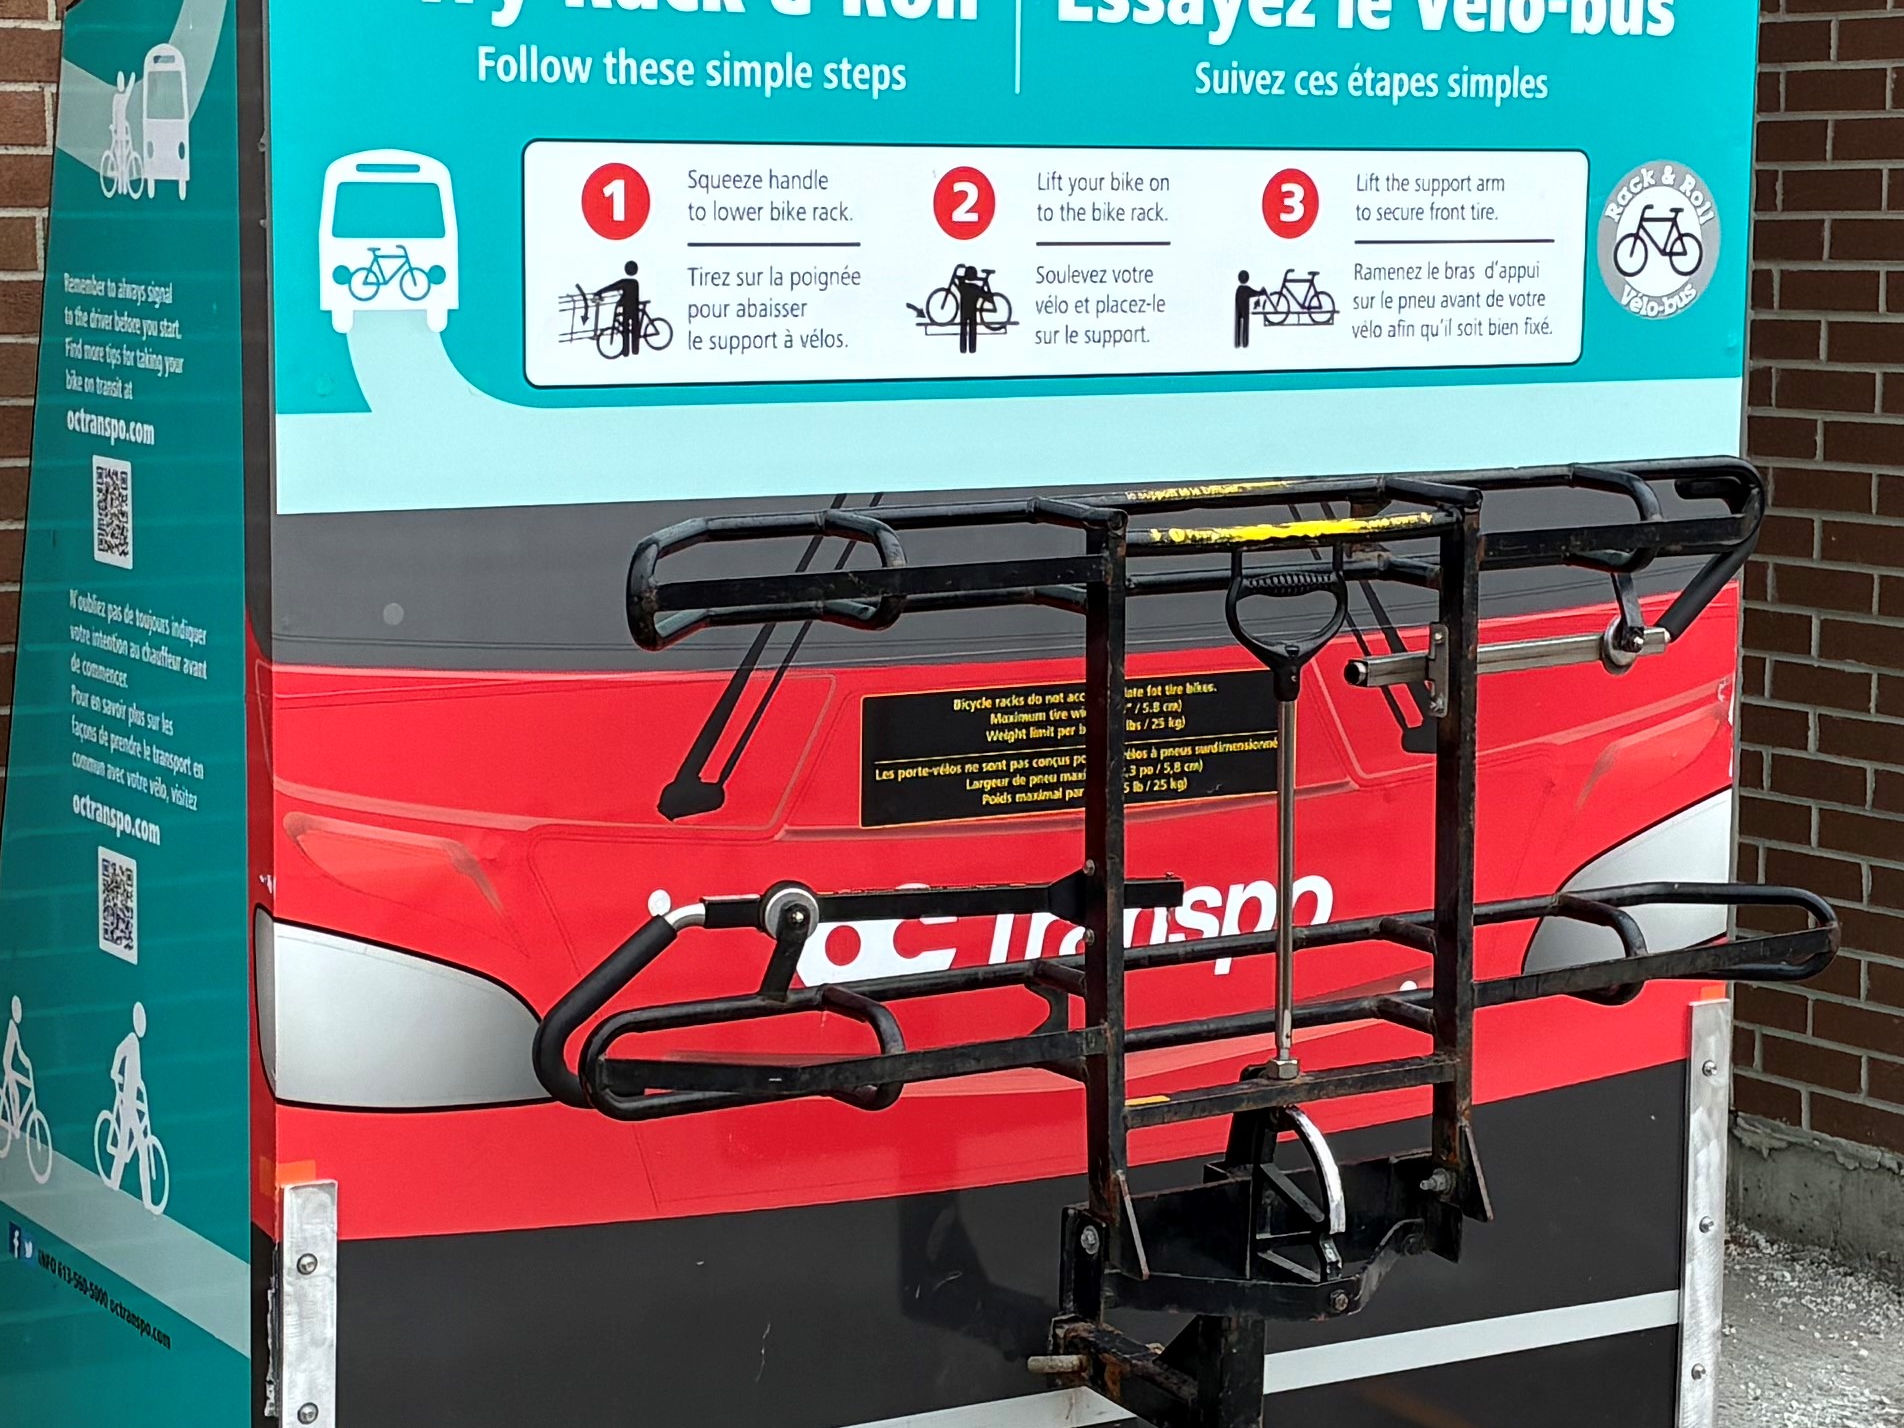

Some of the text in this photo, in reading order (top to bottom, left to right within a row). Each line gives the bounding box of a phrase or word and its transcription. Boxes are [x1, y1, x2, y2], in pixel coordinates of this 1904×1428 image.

[479, 45, 906, 99] Follow these simple steps
[1196, 61, 1547, 106] Suivez ces étapes simples
[688, 169, 828, 194] Squeeze handle
[1038, 171, 1169, 196] Lift your bike on
[1357, 173, 1504, 196] Lift the support arm
[603, 180, 624, 221] 1
[952, 182, 978, 221] 2
[1280, 183, 1304, 221] 3
[1604, 165, 1716, 225] Rack & Roll
[688, 200, 852, 221] to lower bike rack.
[1037, 202, 1168, 221] to the bike rack.
[1356, 202, 1498, 221] to secure front tire.
[687, 265, 861, 291] Tirez sur la poignée
[1036, 265, 1153, 284] Soulevez votre
[1355, 260, 1539, 283] Ramenez le bras d'appui
[64, 273, 172, 308] Remember to always signal
[1353, 290, 1545, 314] sur le pneu avant de votre
[1621, 283, 1696, 317] Vélo-bus
[688, 298, 807, 324] pour abaisser
[1036, 294, 1165, 318] vélo et placez-le
[65, 307, 72, 325] to
[75, 306, 87, 327] the
[90, 308, 112, 330] driver
[114, 310, 141, 335] before
[142, 318, 158, 341] you
[1035, 325, 1149, 348] sur le support.
[1352, 317, 1552, 341] vélo afin qu'il soit bien fixé.
[689, 328, 848, 355] le support à vélos.
[65, 338, 184, 378] Find more tips for taking your
[66, 369, 133, 399] bike on transit at
[67, 408, 154, 446] octranspo.com
[107, 601, 122, 624] pas
[124, 604, 134, 625] de
[135, 609, 169, 636] toujours
[171, 616, 206, 647] indiquer
[70, 624, 207, 679] votre intention au chauffeur avant
[70, 652, 80, 673] de
[71, 685, 173, 736] Pour en savoir plus sur les
[954, 699, 992, 712] Bicycle
[996, 697, 1024, 708] racks
[1028, 694, 1041, 705] do
[1045, 694, 1063, 705] not
[990, 713, 1045, 725] Maximum
[1049, 710, 1068, 721] tire
[986, 729, 1026, 743] Weight
[1058, 725, 1075, 739] per
[71, 715, 203, 780] façons de prendre le transport en
[72, 751, 105, 775] commun
[107, 763, 124, 782] avec
[127, 770, 147, 793] votre
[171, 783, 197, 810] visitez
[876, 768, 894, 781] Les
[965, 763, 979, 772] ne
[1010, 758, 1029, 769] pas
[966, 775, 1026, 792] Largeur de
[983, 788, 1084, 805] Poids par
[73, 793, 160, 846] octranspo.com
[38, 1249, 57, 1274] INFO
